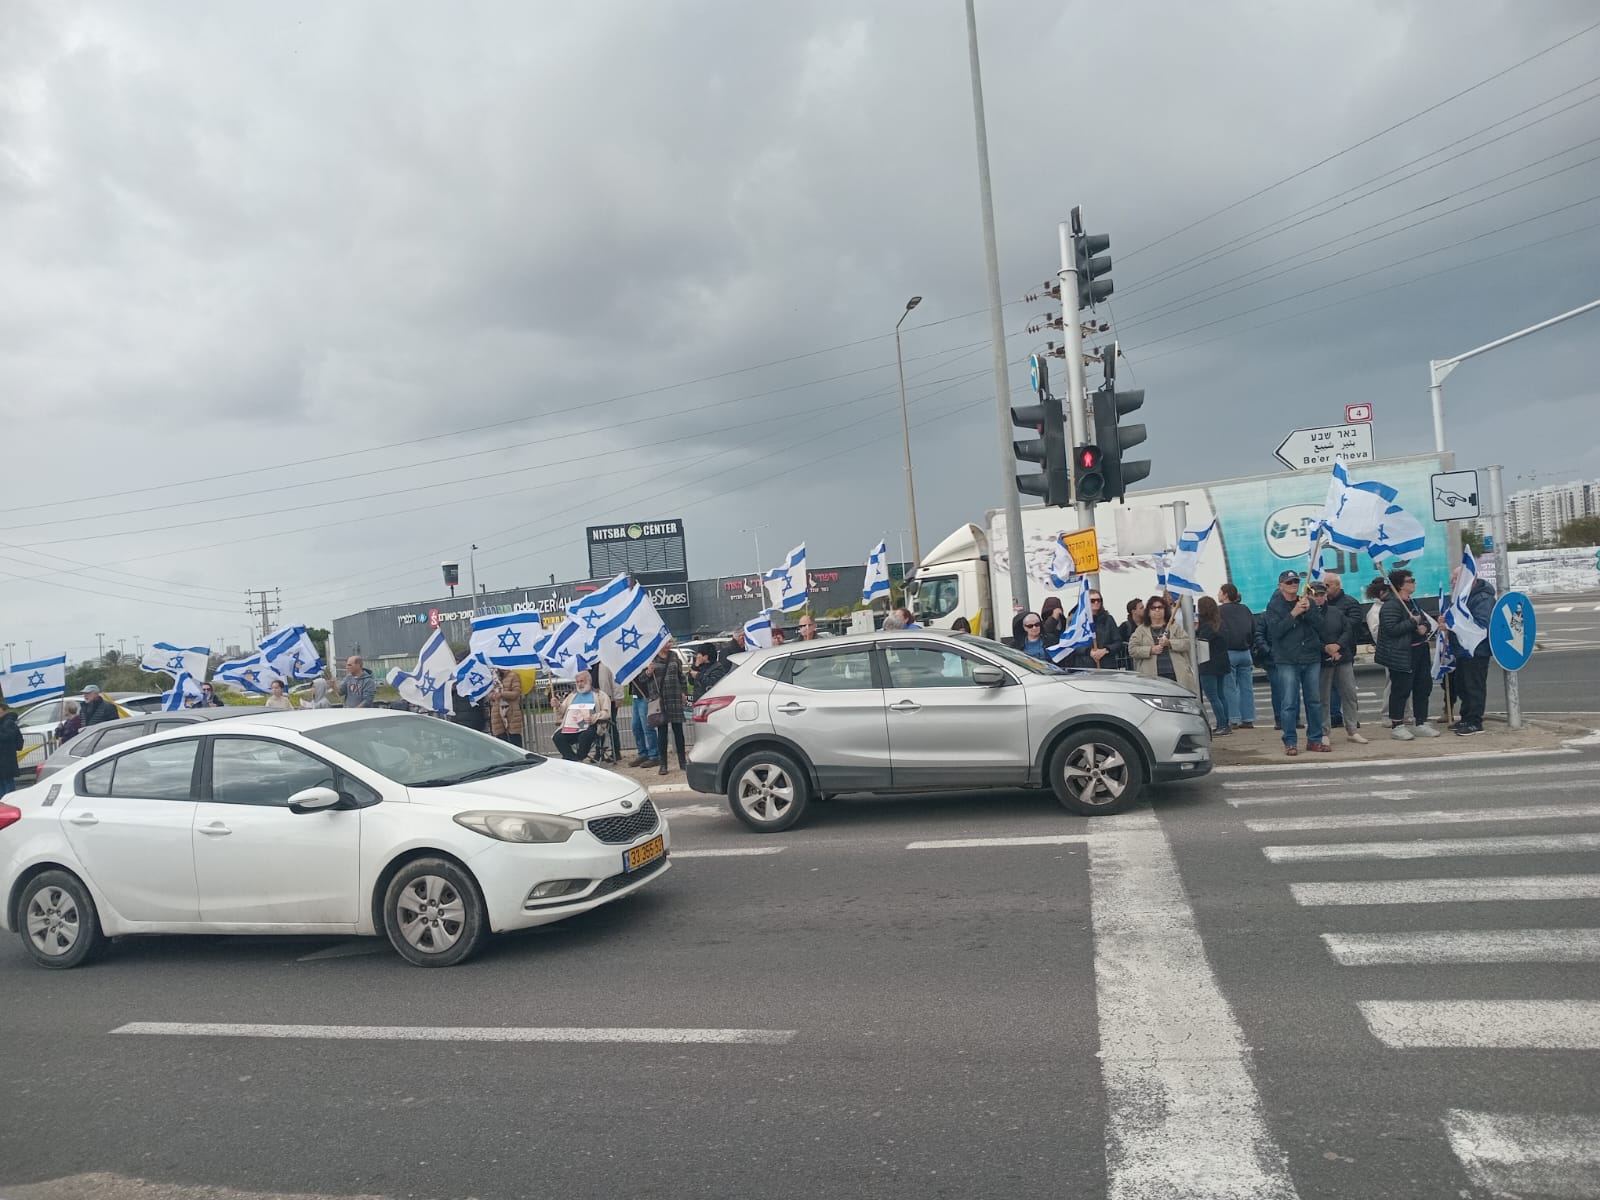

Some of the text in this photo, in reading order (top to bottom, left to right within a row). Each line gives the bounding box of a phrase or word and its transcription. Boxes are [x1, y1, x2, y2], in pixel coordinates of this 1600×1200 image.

[1311, 429, 1357, 441] באר שבע
[1303, 455, 1330, 464] Be'er
[592, 522, 677, 541] NITSBA CENTER
[438, 610, 474, 622] סופר-פארם
